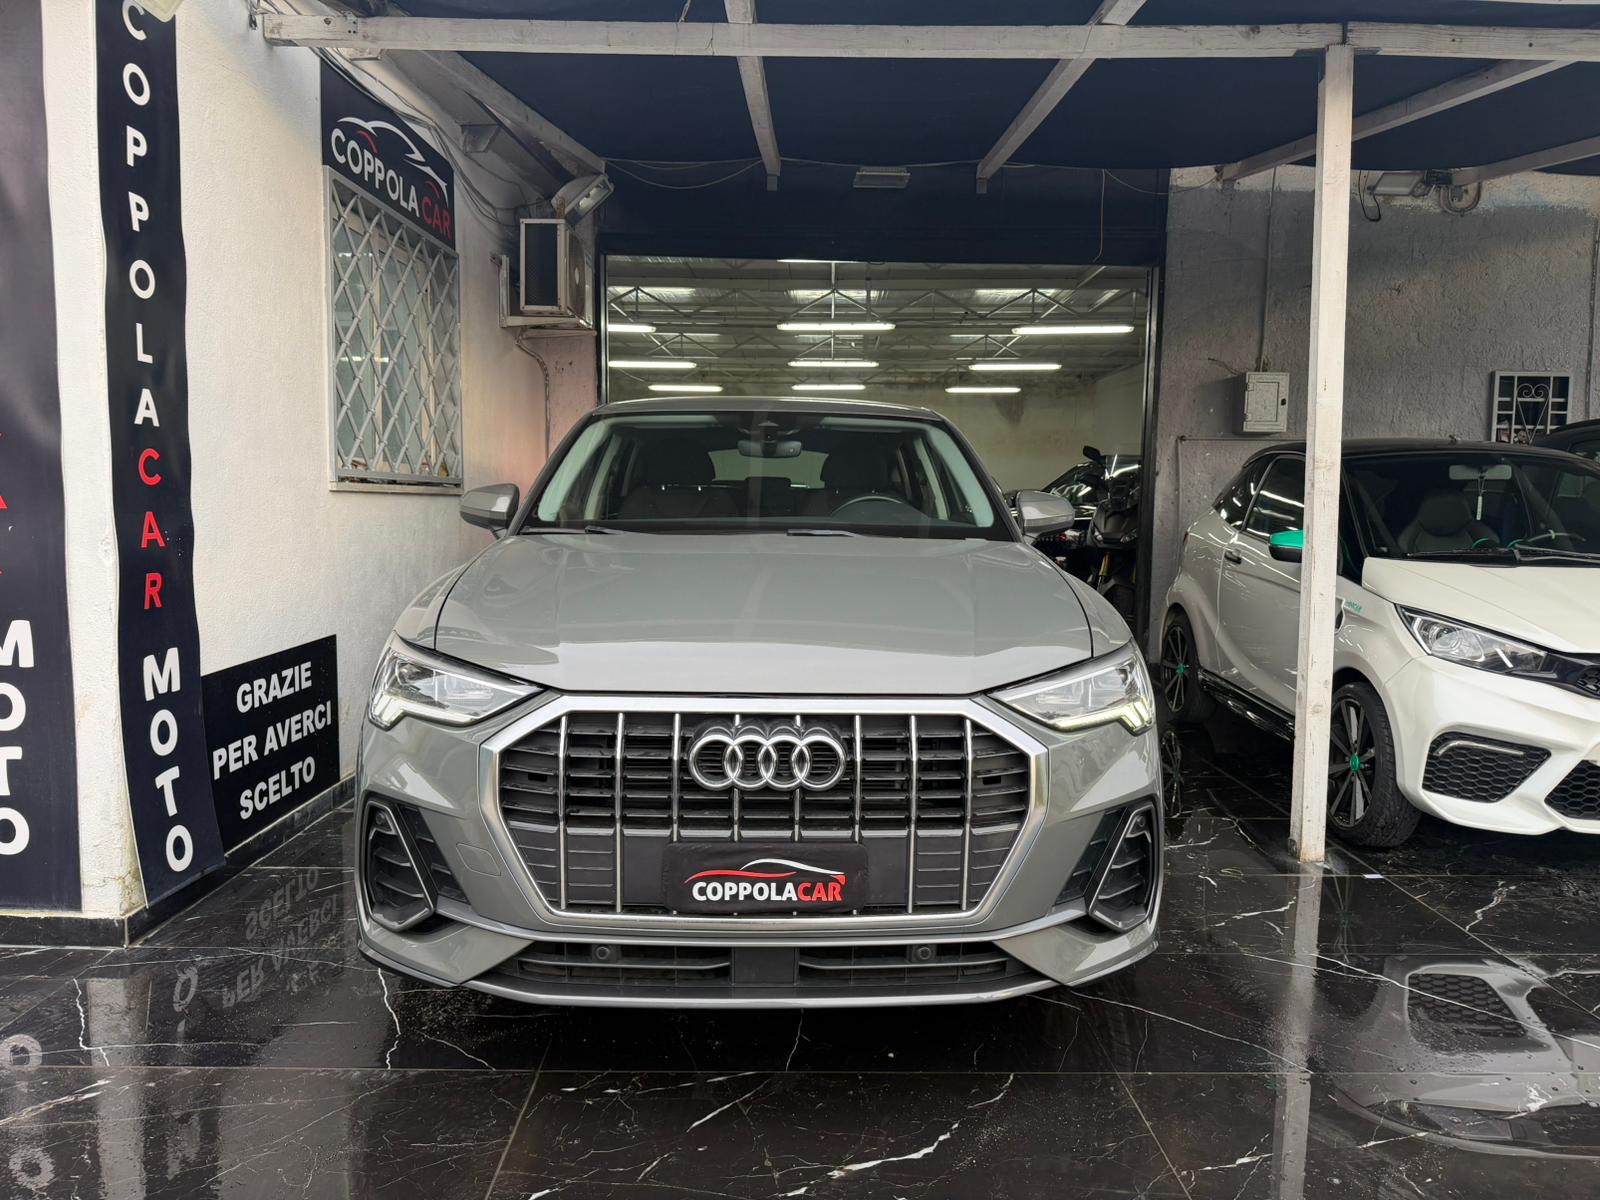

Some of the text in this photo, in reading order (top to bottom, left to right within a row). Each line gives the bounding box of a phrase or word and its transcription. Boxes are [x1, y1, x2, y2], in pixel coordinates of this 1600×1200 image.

[236, 661, 312, 713] GRAZIE
[142, 647, 194, 872] MOTO
[213, 700, 332, 780] PER AVERCI
[240, 756, 316, 820] SCELTO
[692, 881, 842, 902] COPPOLACAR
